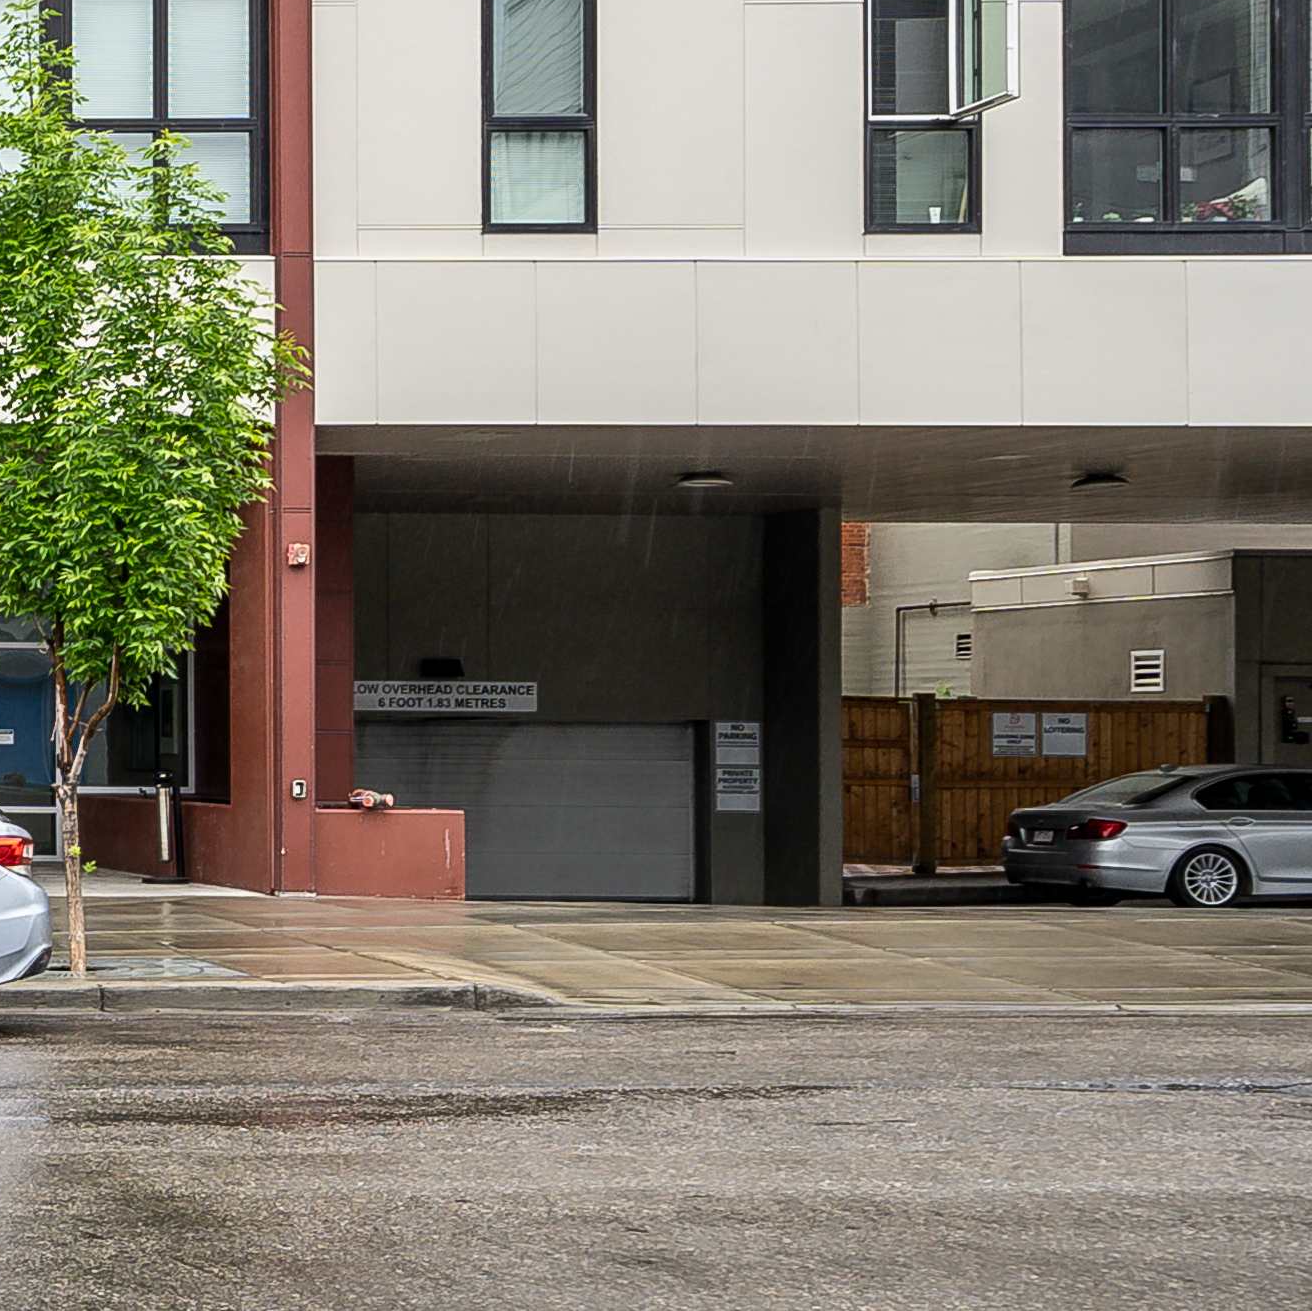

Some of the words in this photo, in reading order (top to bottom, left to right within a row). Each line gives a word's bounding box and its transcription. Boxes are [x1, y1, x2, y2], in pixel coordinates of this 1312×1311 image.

[381, 683, 452, 695] OVERHEAD
[455, 684, 534, 696] CLEARANCE
[377, 697, 386, 708] 6
[389, 697, 424, 708] FOOT
[427, 697, 452, 708] 1.83
[454, 697, 507, 709] METRES
